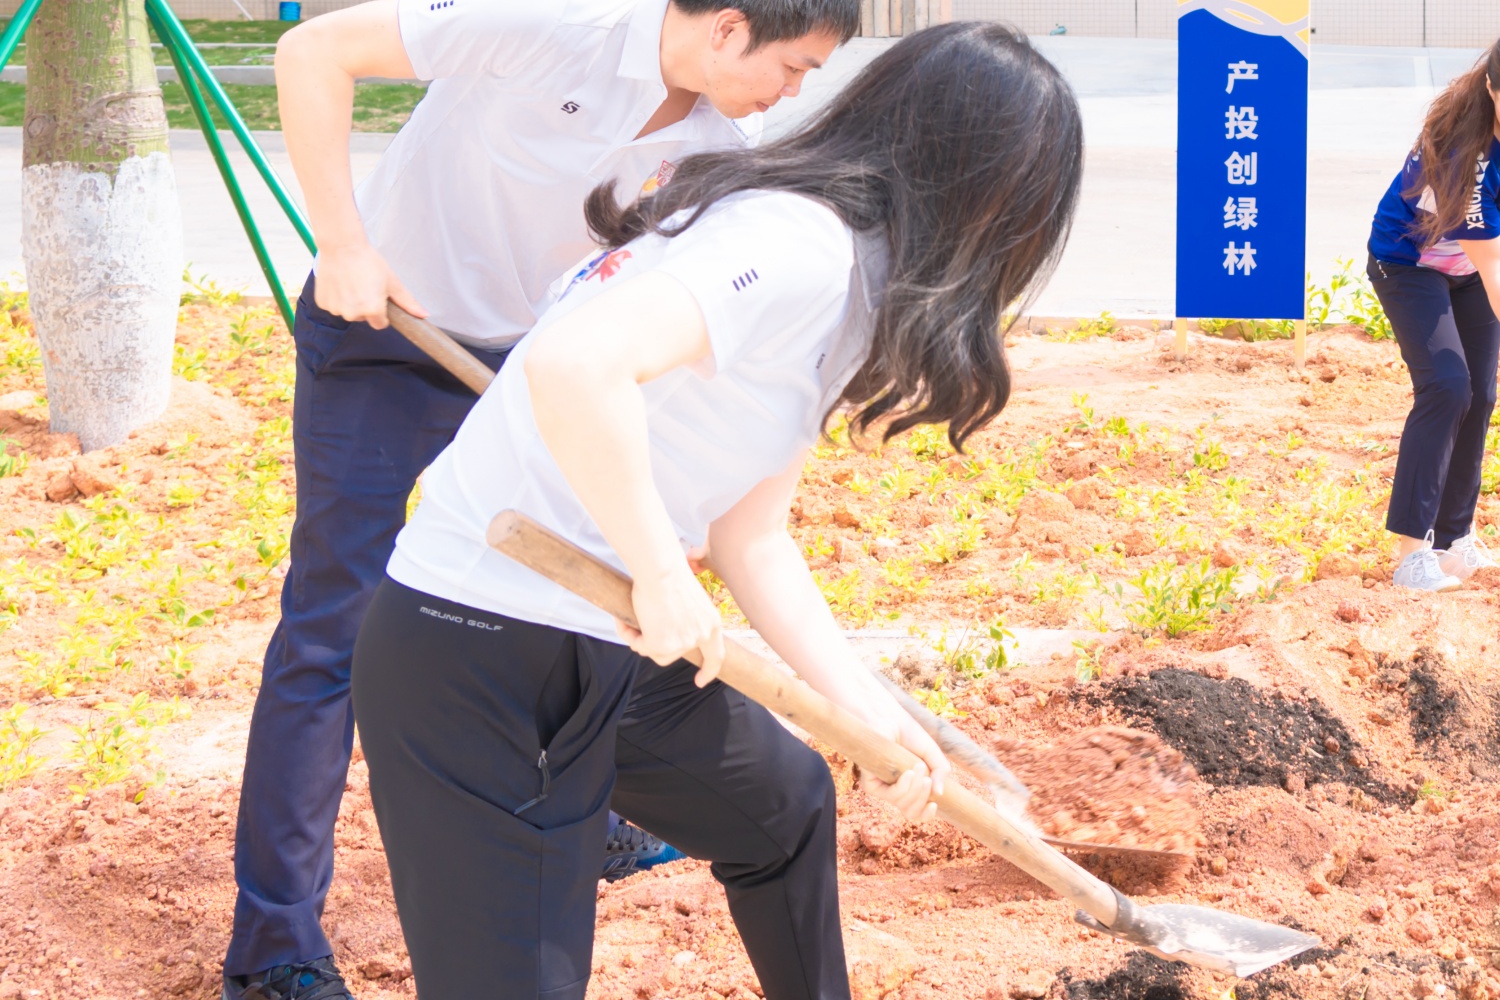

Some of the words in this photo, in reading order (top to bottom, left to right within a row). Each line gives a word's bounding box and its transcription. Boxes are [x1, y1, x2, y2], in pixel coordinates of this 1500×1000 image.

[1222, 59, 1260, 277] 产投创绿林
[420, 606, 464, 624] MIZUNO
[467, 619, 504, 631] GOLF
